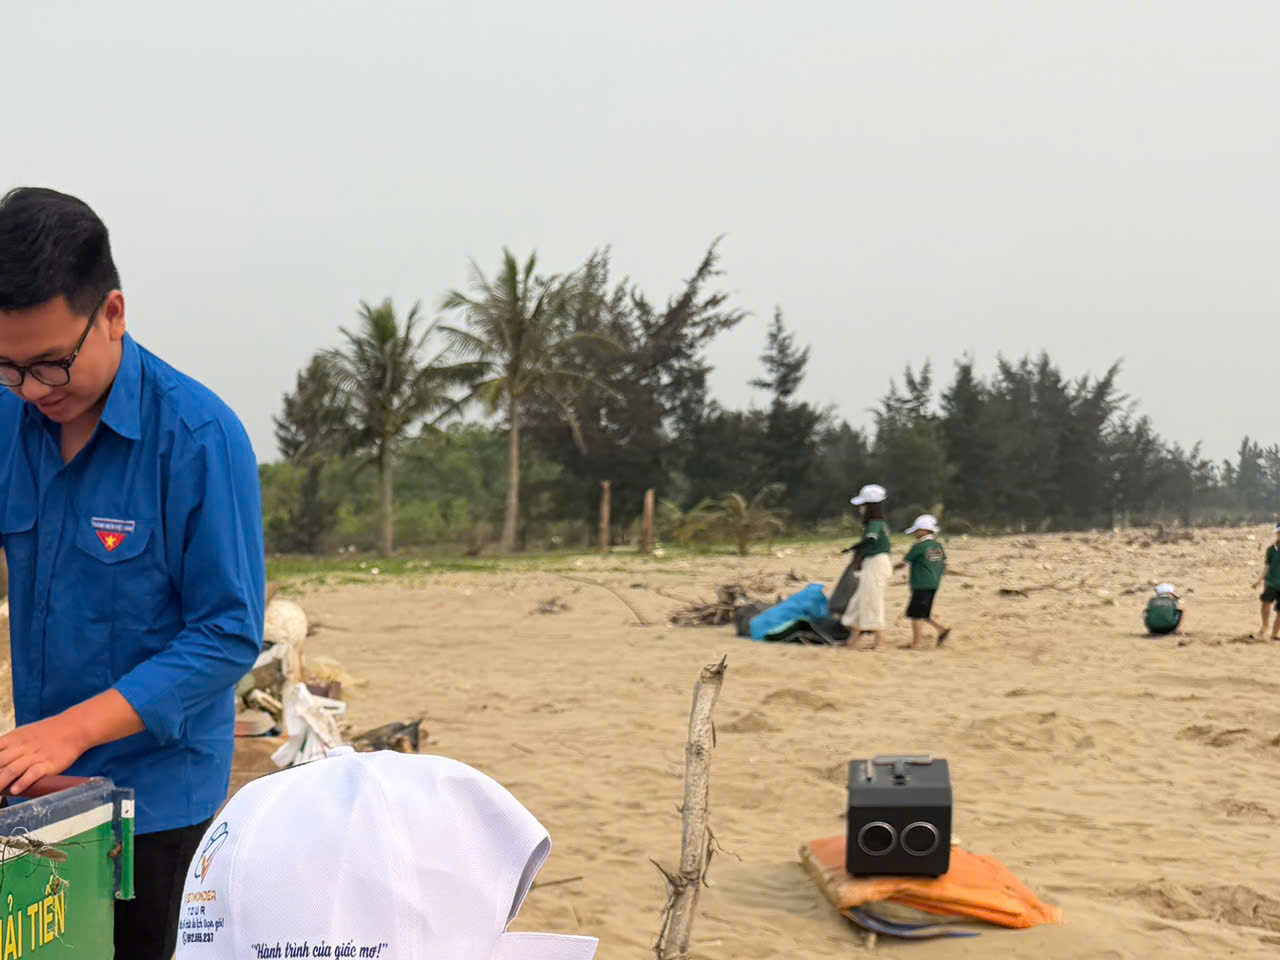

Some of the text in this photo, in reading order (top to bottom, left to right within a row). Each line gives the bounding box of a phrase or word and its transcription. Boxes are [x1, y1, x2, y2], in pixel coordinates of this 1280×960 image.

[27, 876, 66, 951] TIẾN
[284, 940, 310, 959] trình
[312, 939, 332, 959] của
